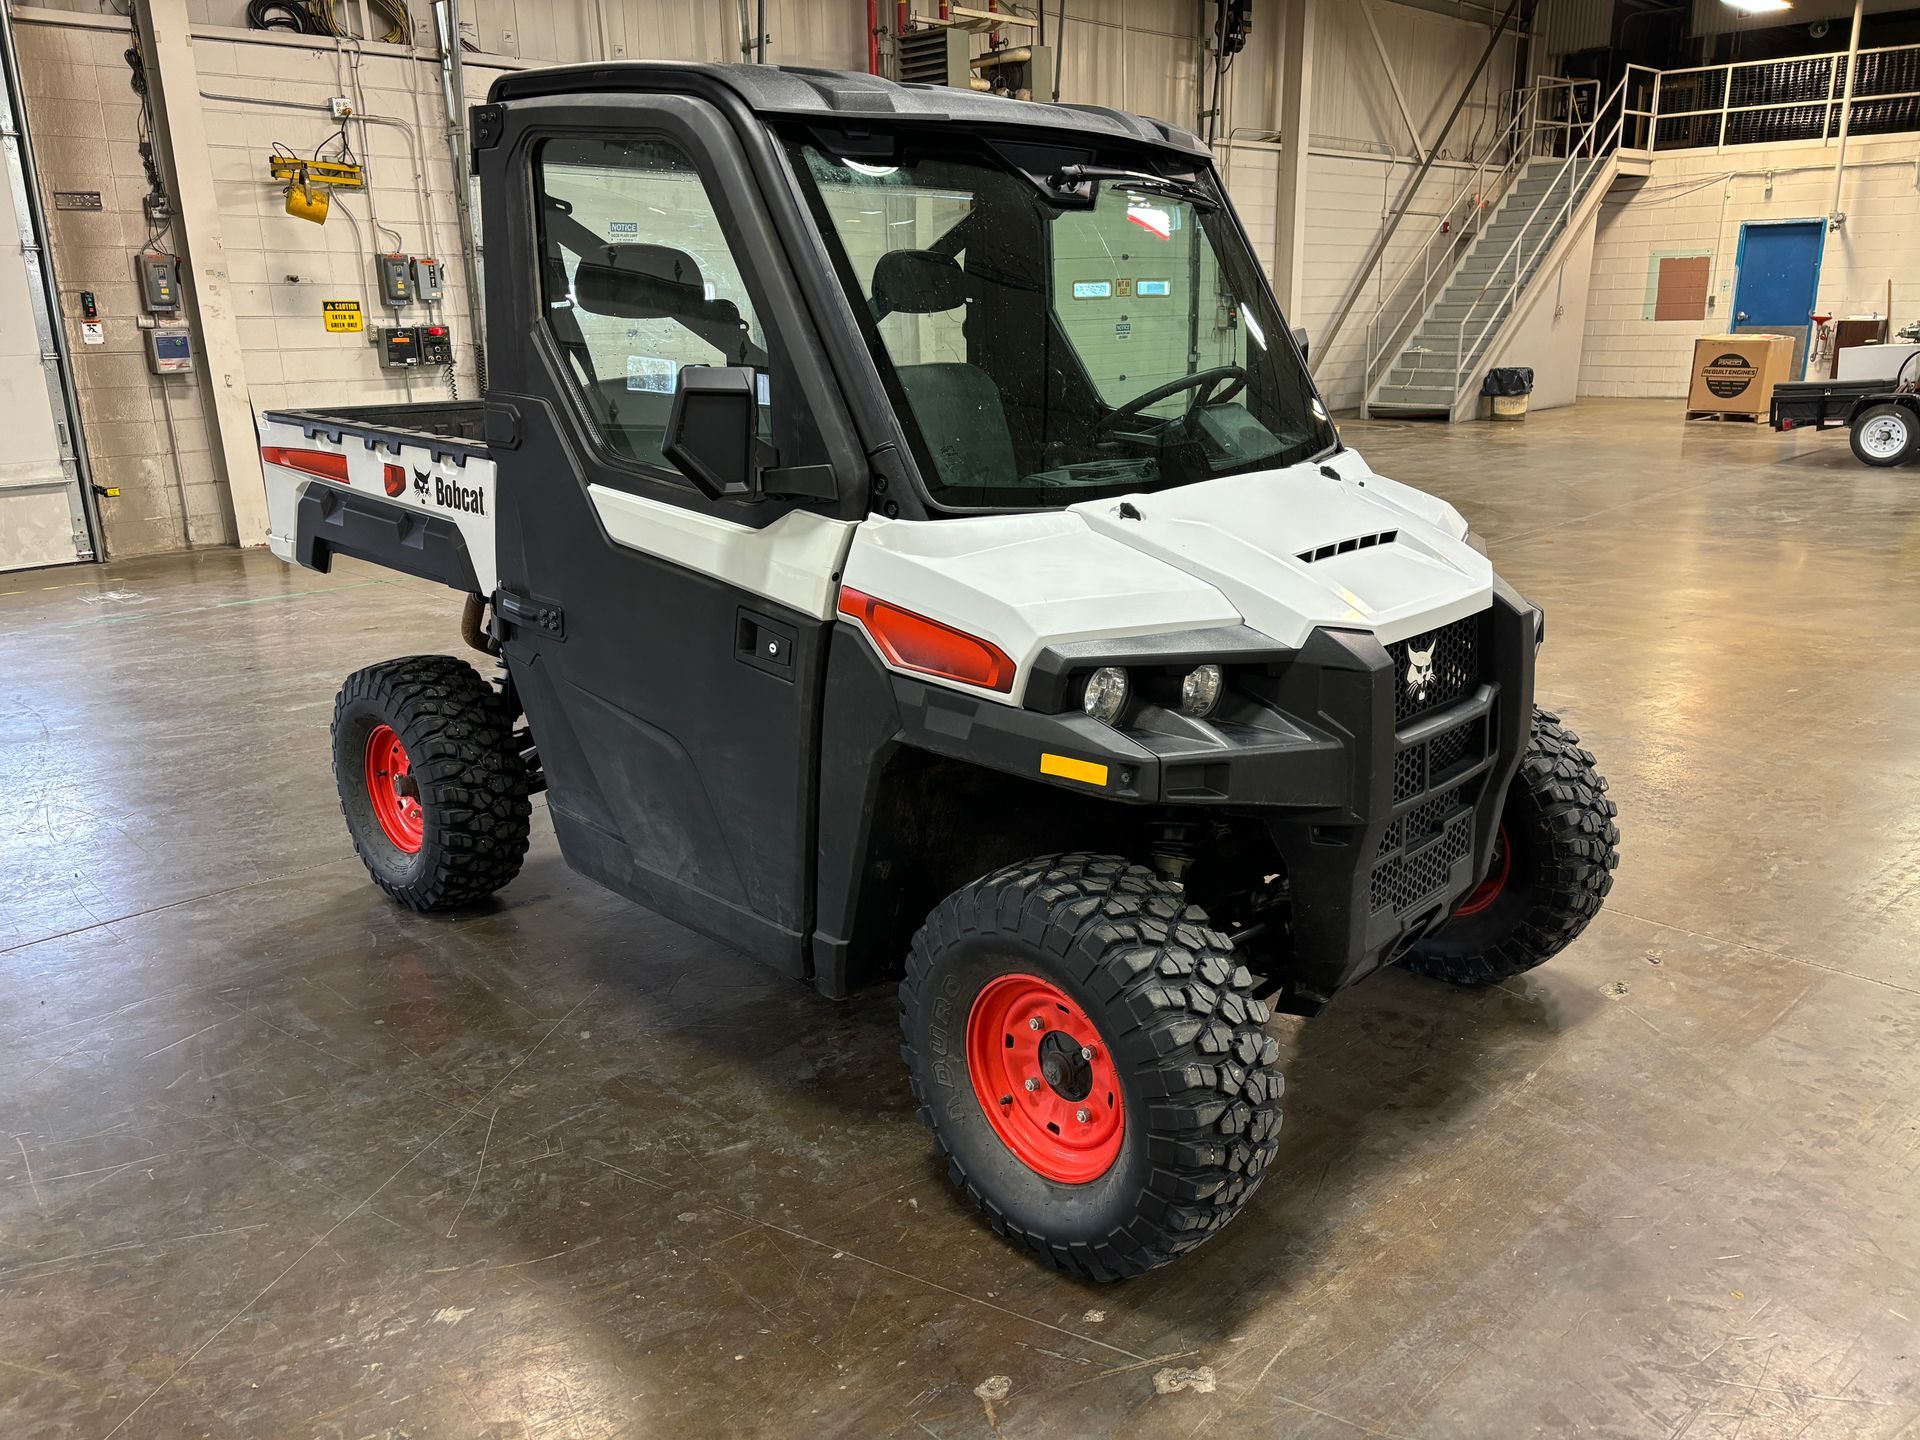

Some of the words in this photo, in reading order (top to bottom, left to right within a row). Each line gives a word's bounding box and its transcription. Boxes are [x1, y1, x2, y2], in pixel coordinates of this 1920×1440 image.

[611, 223, 637, 231] NOTICE
[435, 476, 485, 516] Bobcat
[929, 974, 963, 1088] DURO
